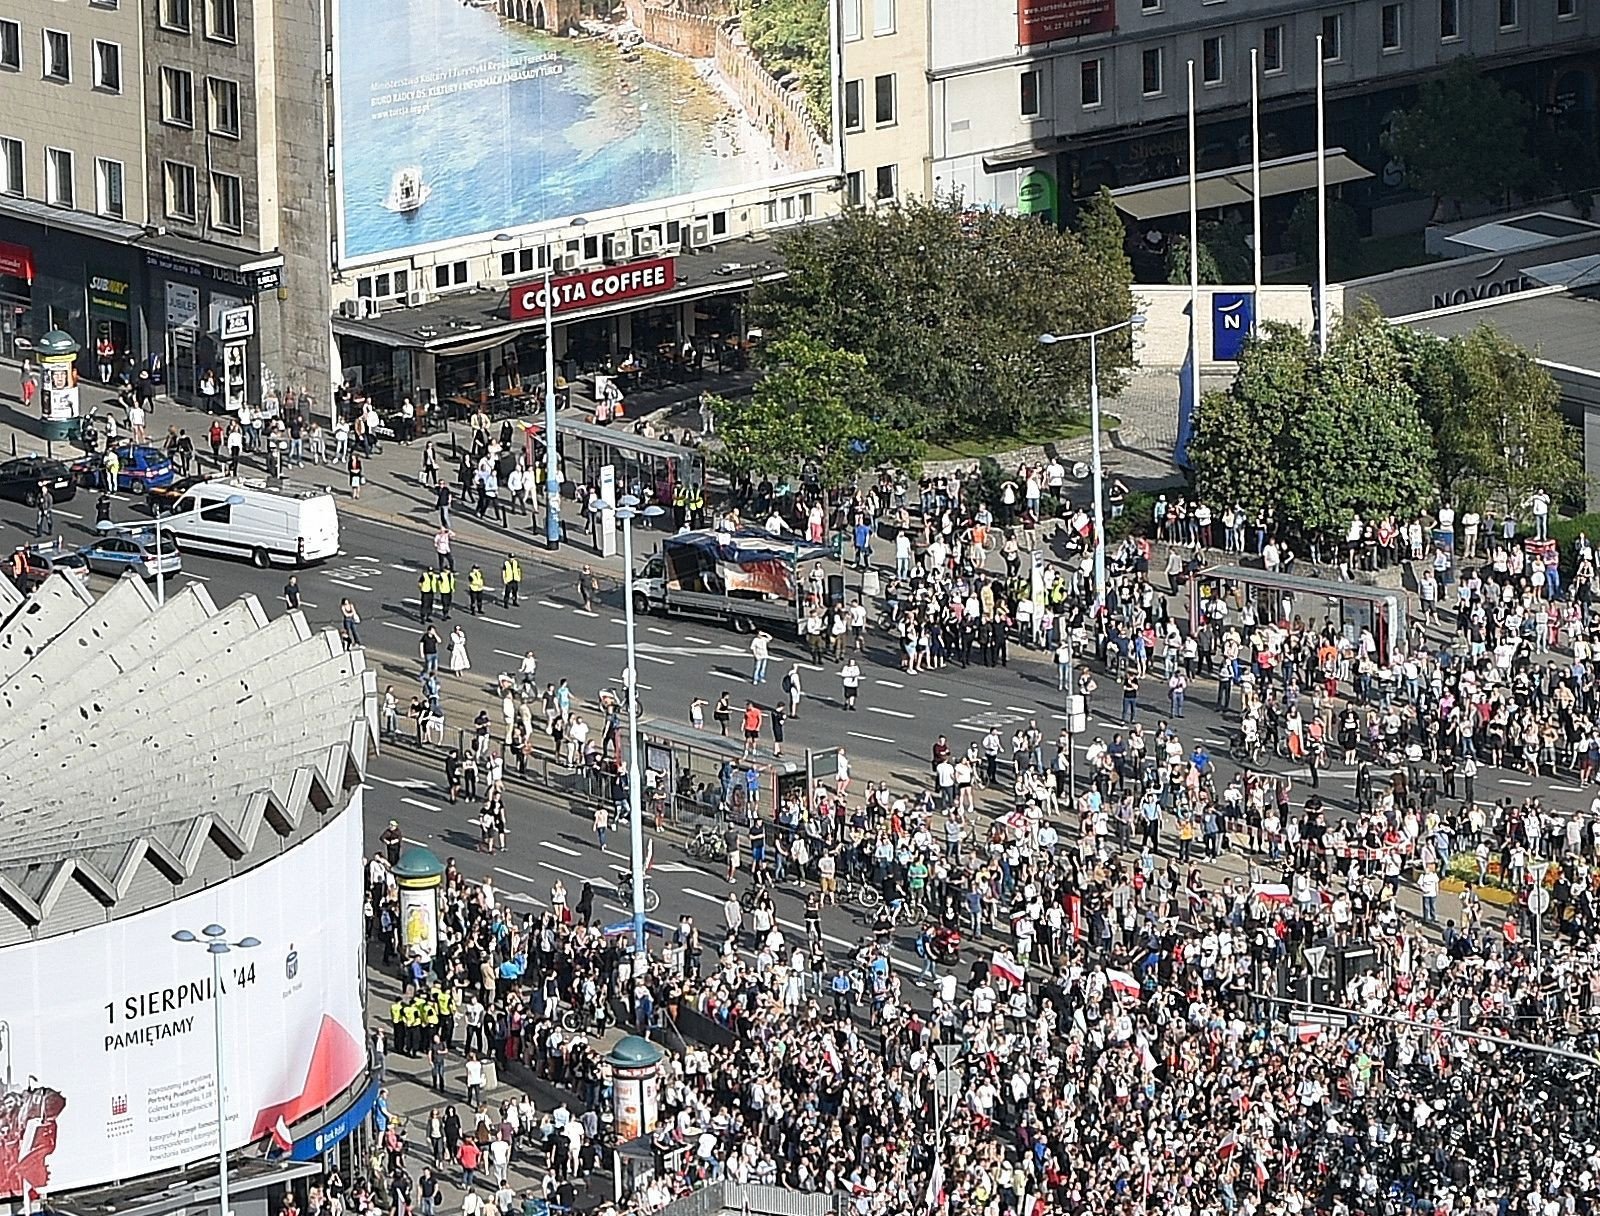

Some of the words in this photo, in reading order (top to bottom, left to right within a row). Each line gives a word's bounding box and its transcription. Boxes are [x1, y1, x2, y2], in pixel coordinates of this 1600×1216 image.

[90, 276, 128, 294] SUBWAY
[522, 282, 586, 310] COSTA
[591, 266, 665, 297] COFFEE
[1225, 314, 1239, 328] N
[104, 1002, 114, 1024] 1
[233, 962, 256, 988] '44
[104, 1016, 194, 1051] PAMIĘTAMY
